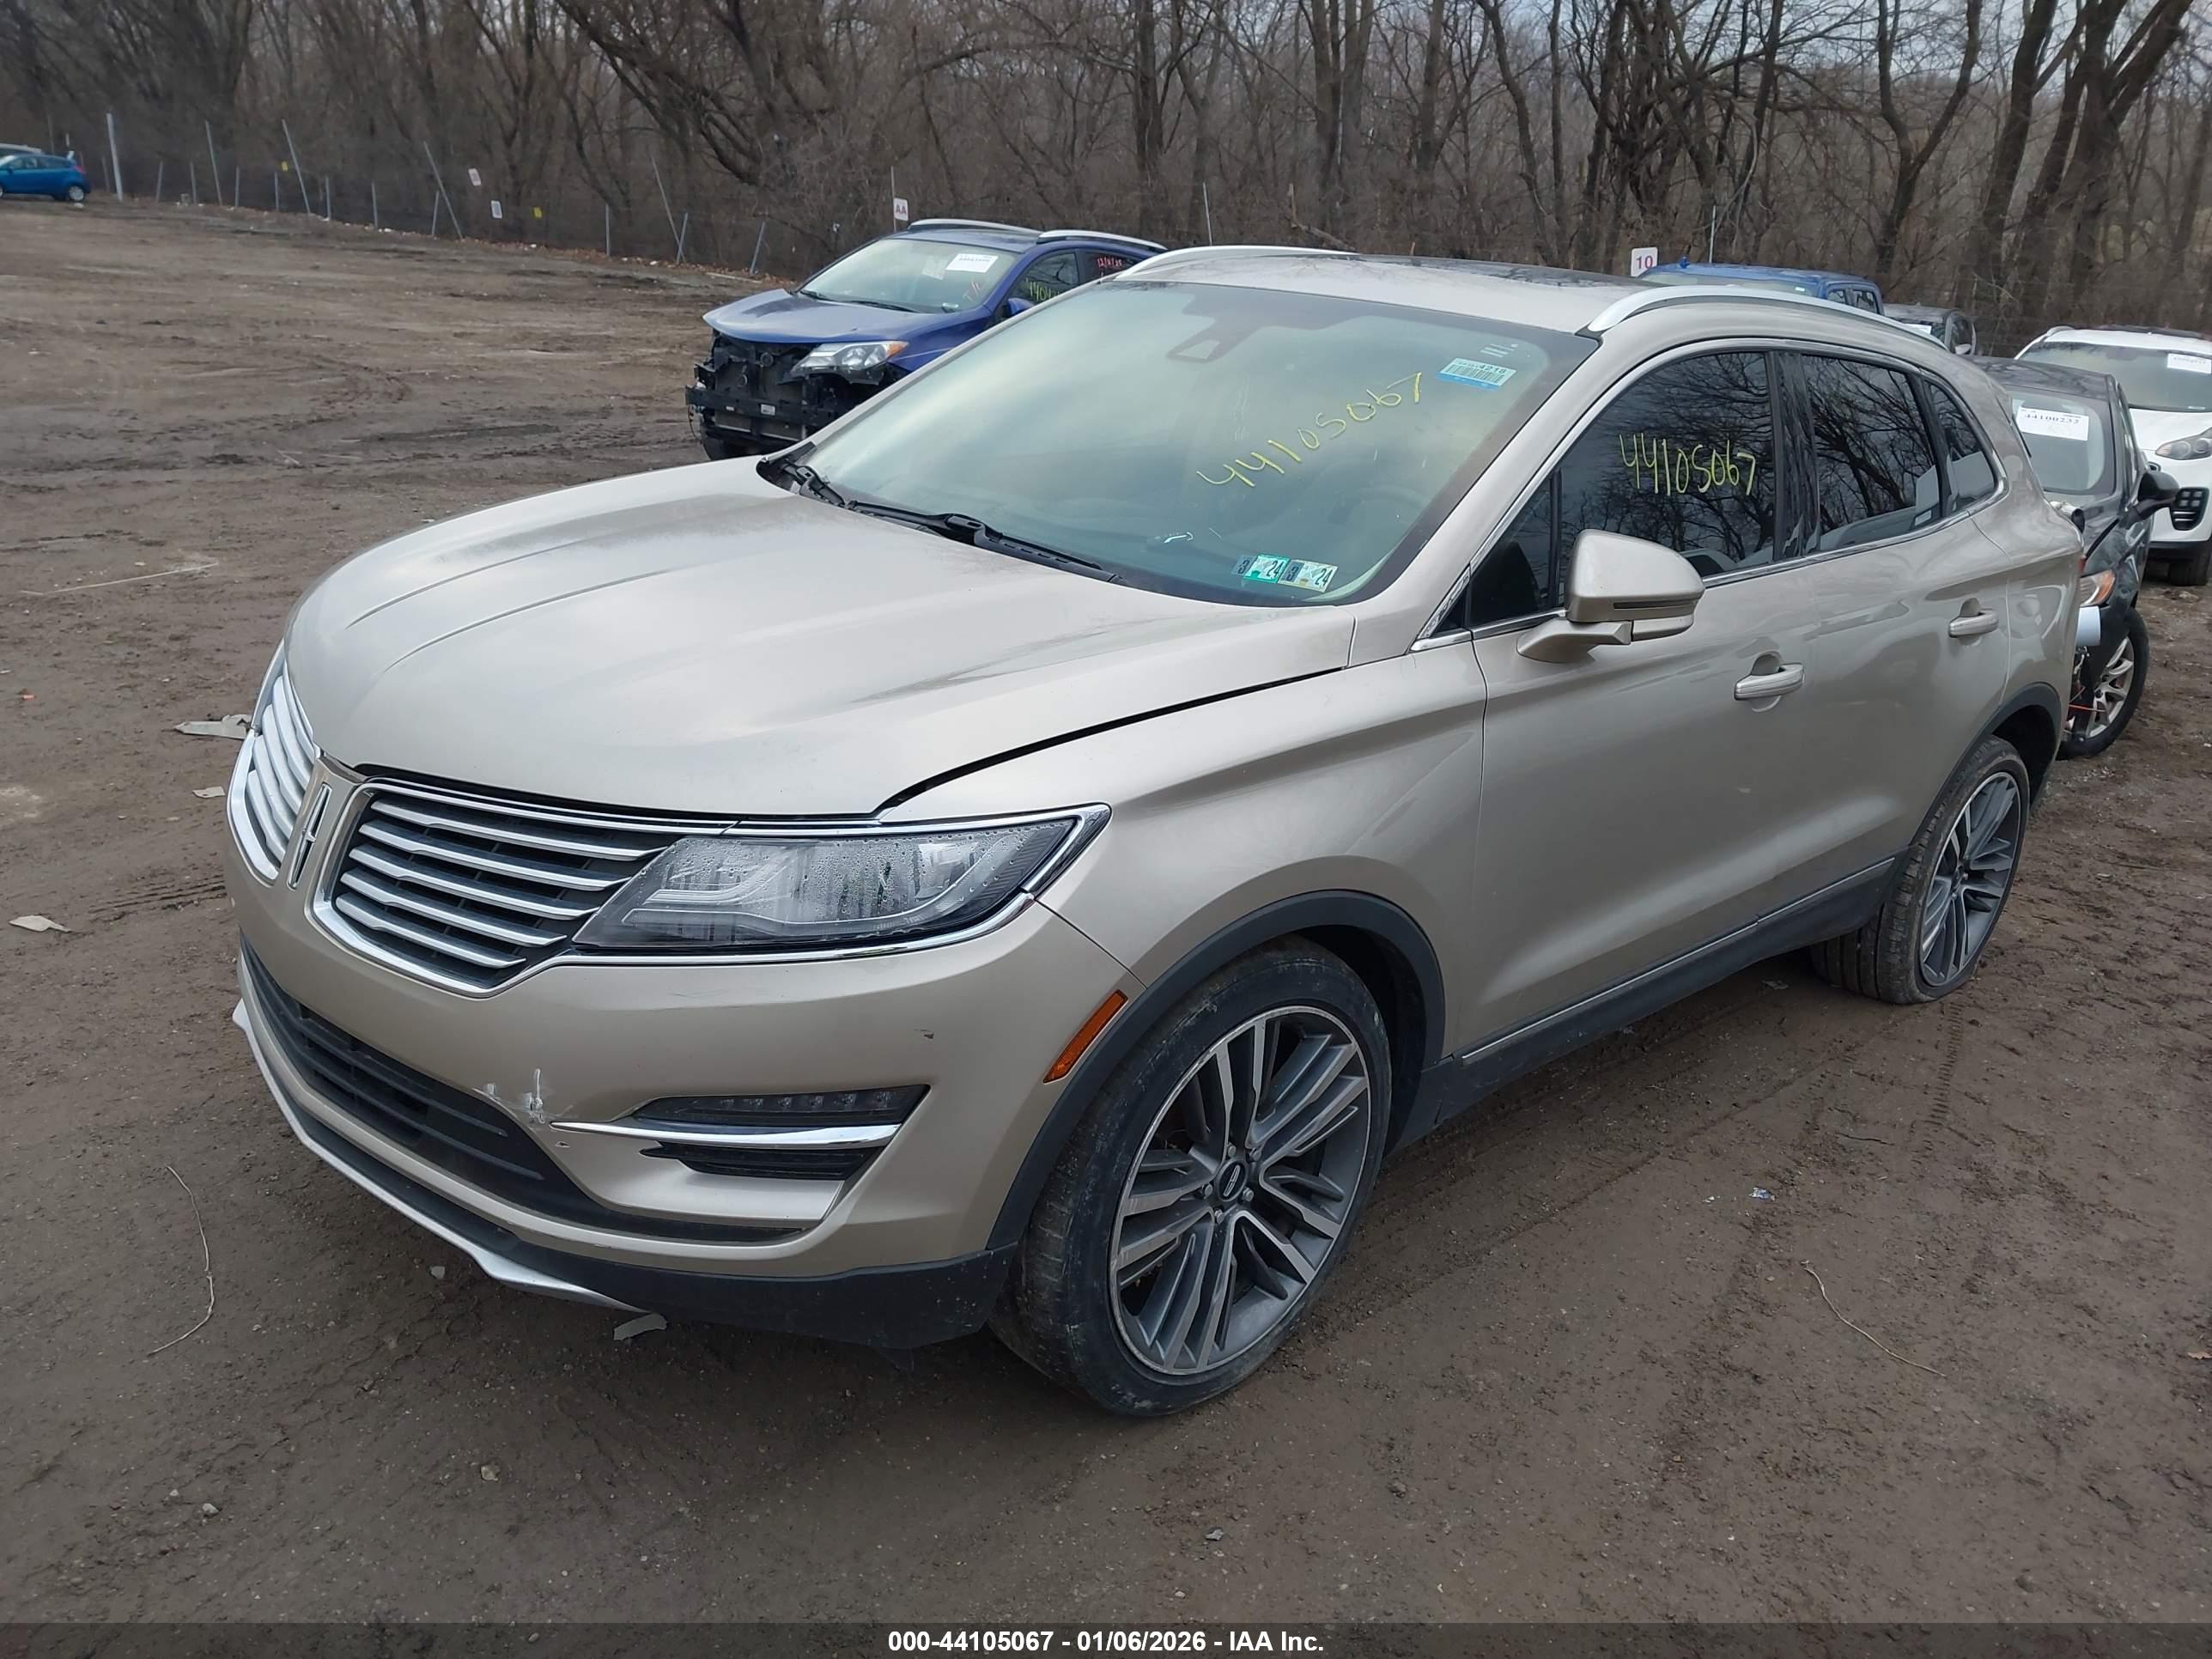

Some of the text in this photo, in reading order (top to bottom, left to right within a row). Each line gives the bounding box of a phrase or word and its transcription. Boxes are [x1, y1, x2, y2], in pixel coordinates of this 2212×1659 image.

[1636, 255, 1653, 270] 10
[1195, 371, 1423, 488] 44105067
[1620, 432, 1756, 496] 44105067
[1237, 559, 1283, 579] 3 24
[1314, 568, 1334, 586] 24
